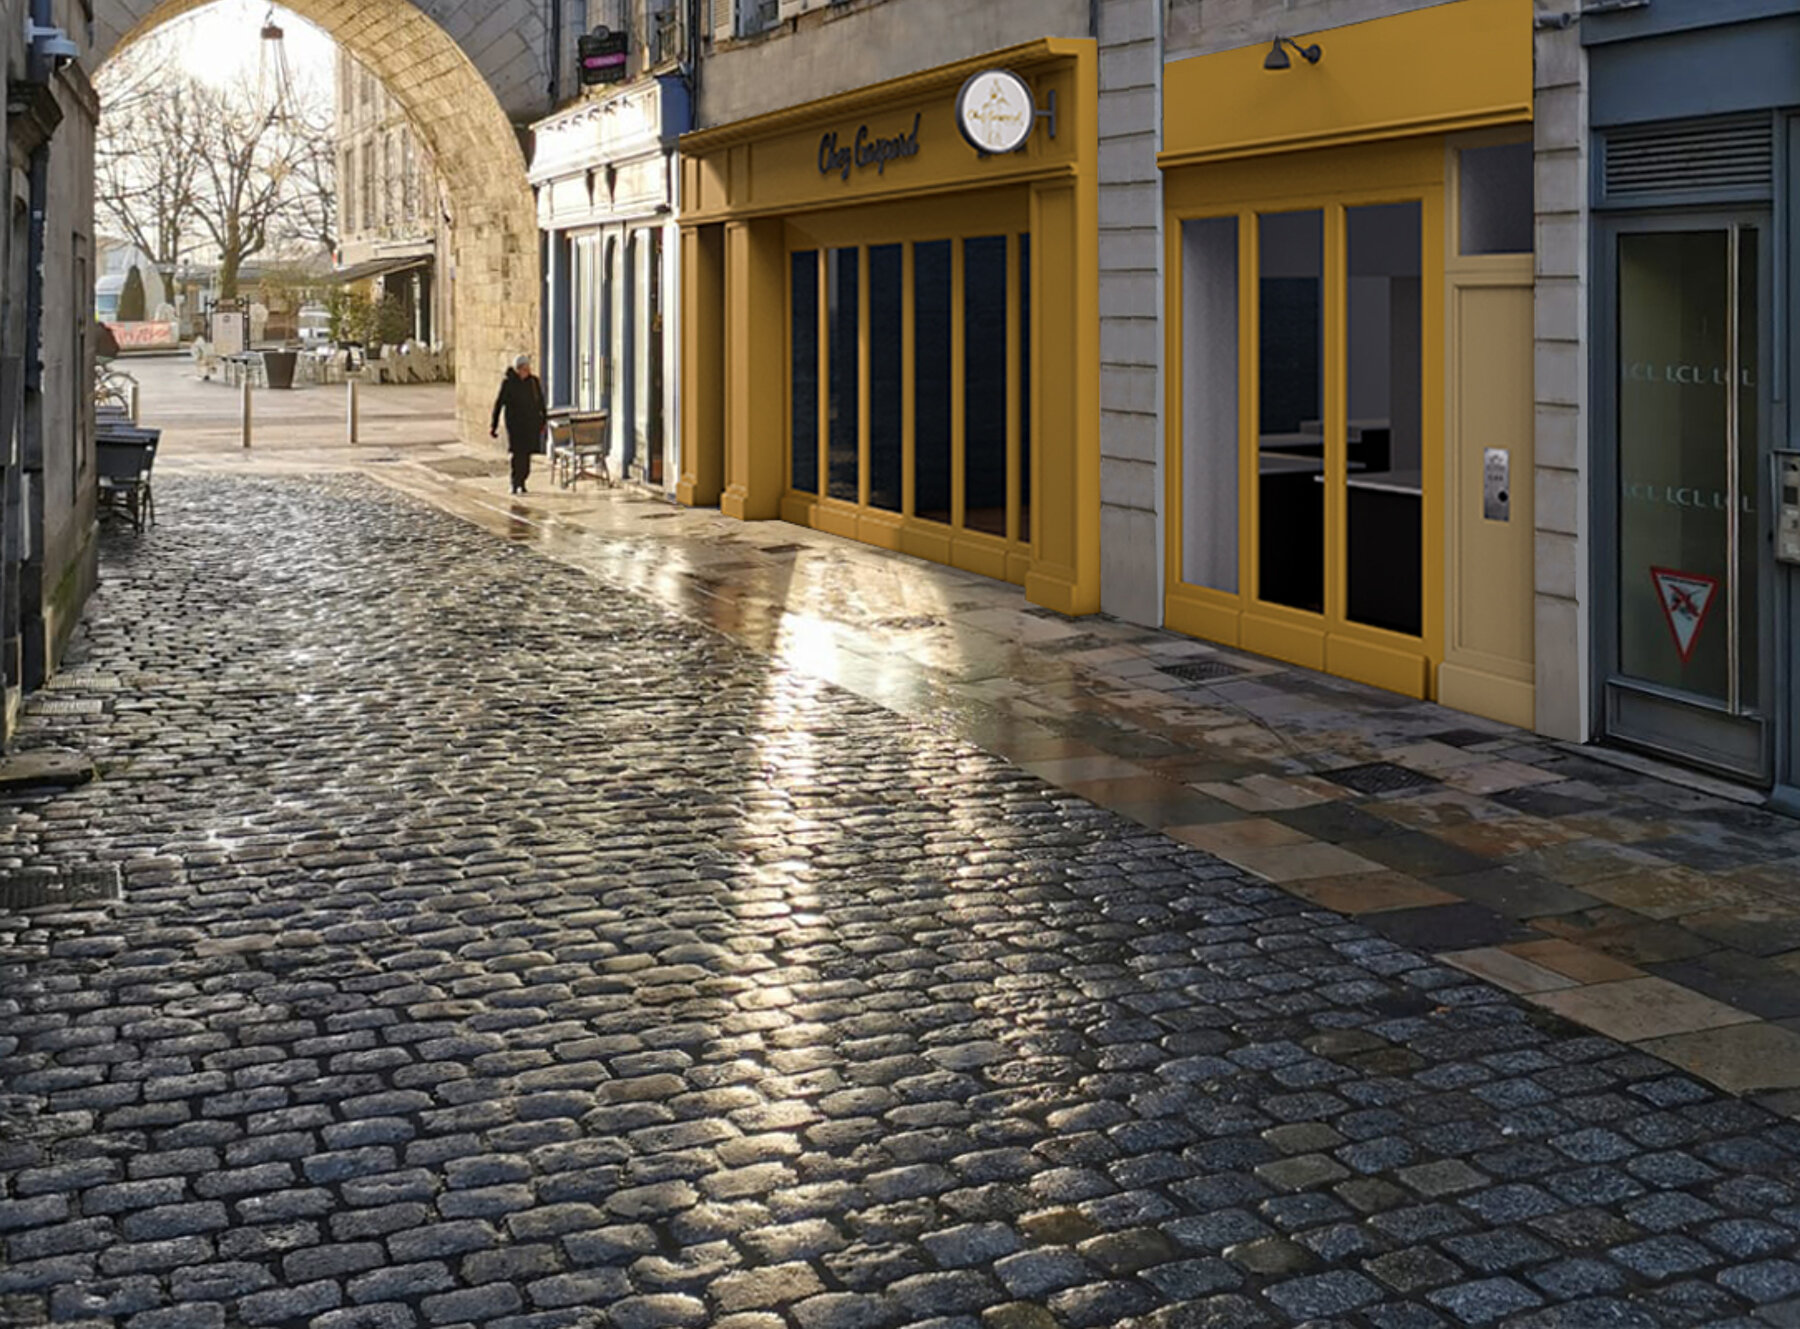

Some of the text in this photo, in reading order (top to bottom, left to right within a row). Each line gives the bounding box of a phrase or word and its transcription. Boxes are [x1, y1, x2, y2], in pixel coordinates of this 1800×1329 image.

[818, 113, 921, 180] Chez Gaspard
[1666, 364, 1705, 383] LCL
[1713, 366, 1755, 387] LL
[1666, 486, 1706, 507] LCL
[1713, 491, 1755, 513] LL
